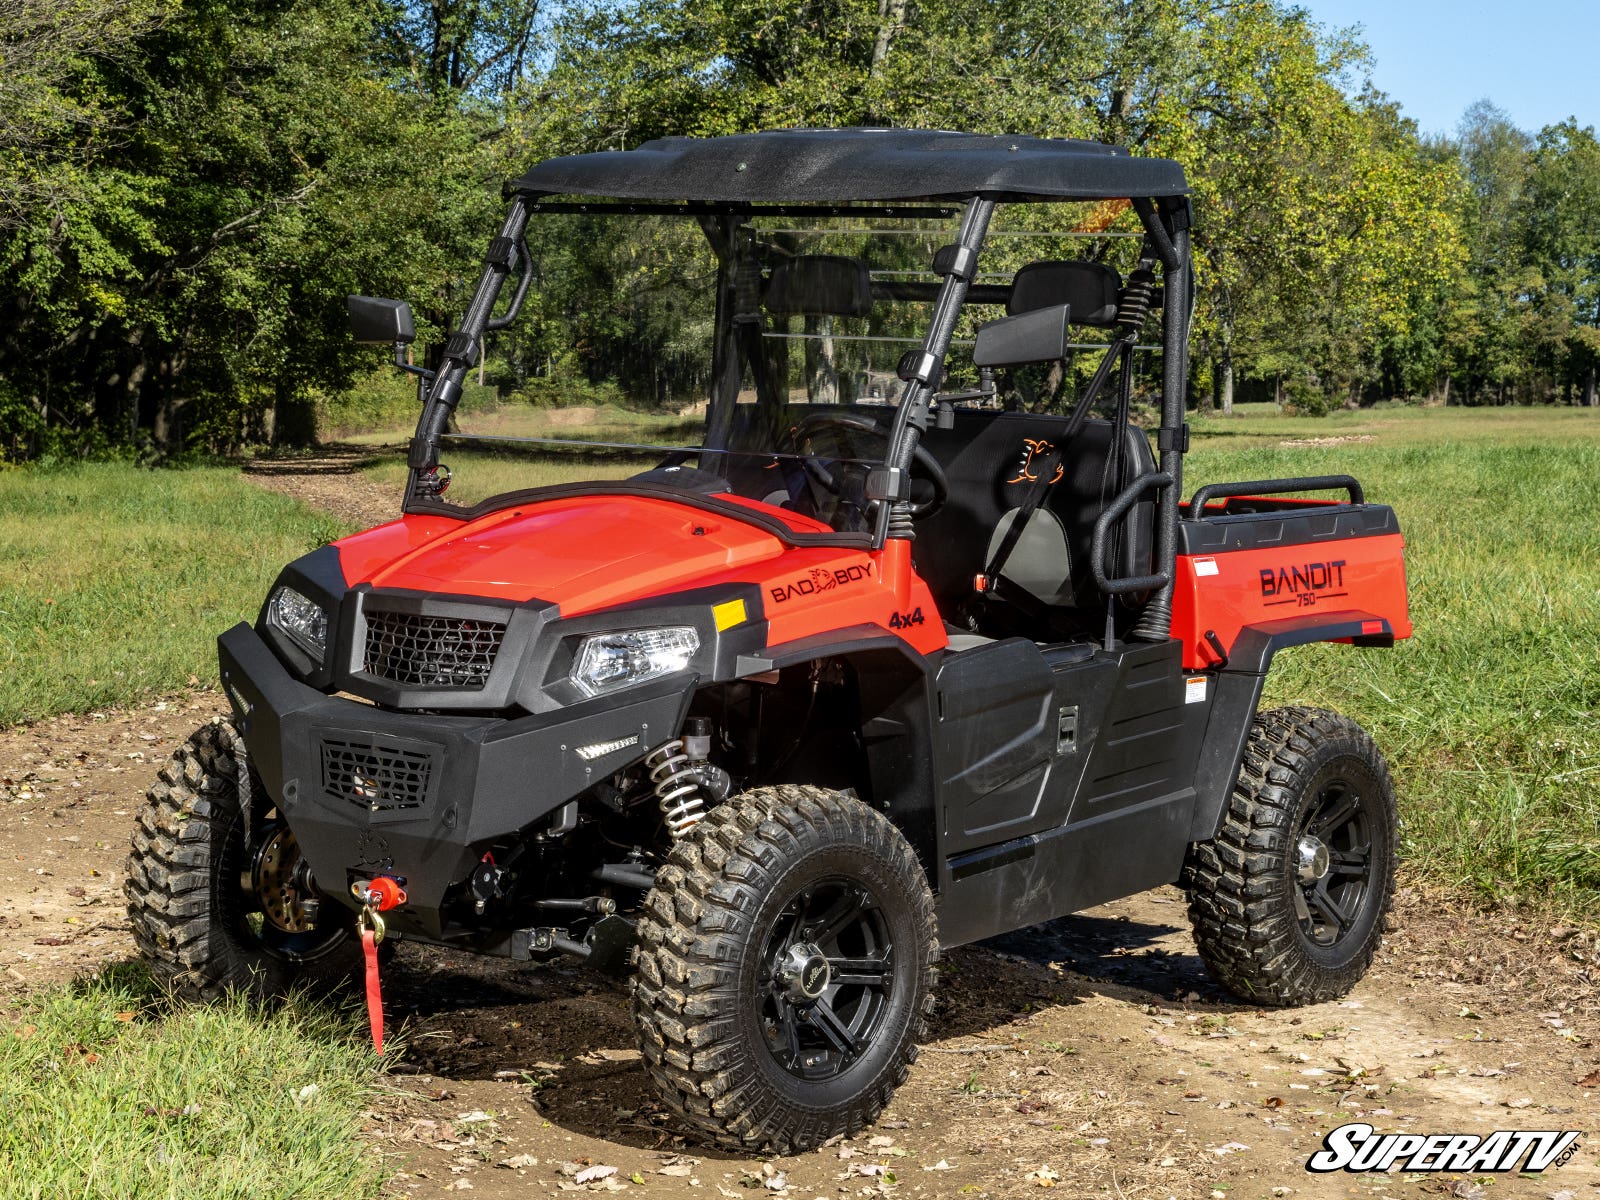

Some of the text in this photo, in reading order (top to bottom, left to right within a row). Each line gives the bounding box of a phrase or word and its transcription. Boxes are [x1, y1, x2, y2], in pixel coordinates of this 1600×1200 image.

[770, 563, 872, 603] BAD BOY
[1260, 560, 1347, 596] BANDIT
[1296, 592, 1316, 607] 750
[889, 607, 925, 630] 4x4
